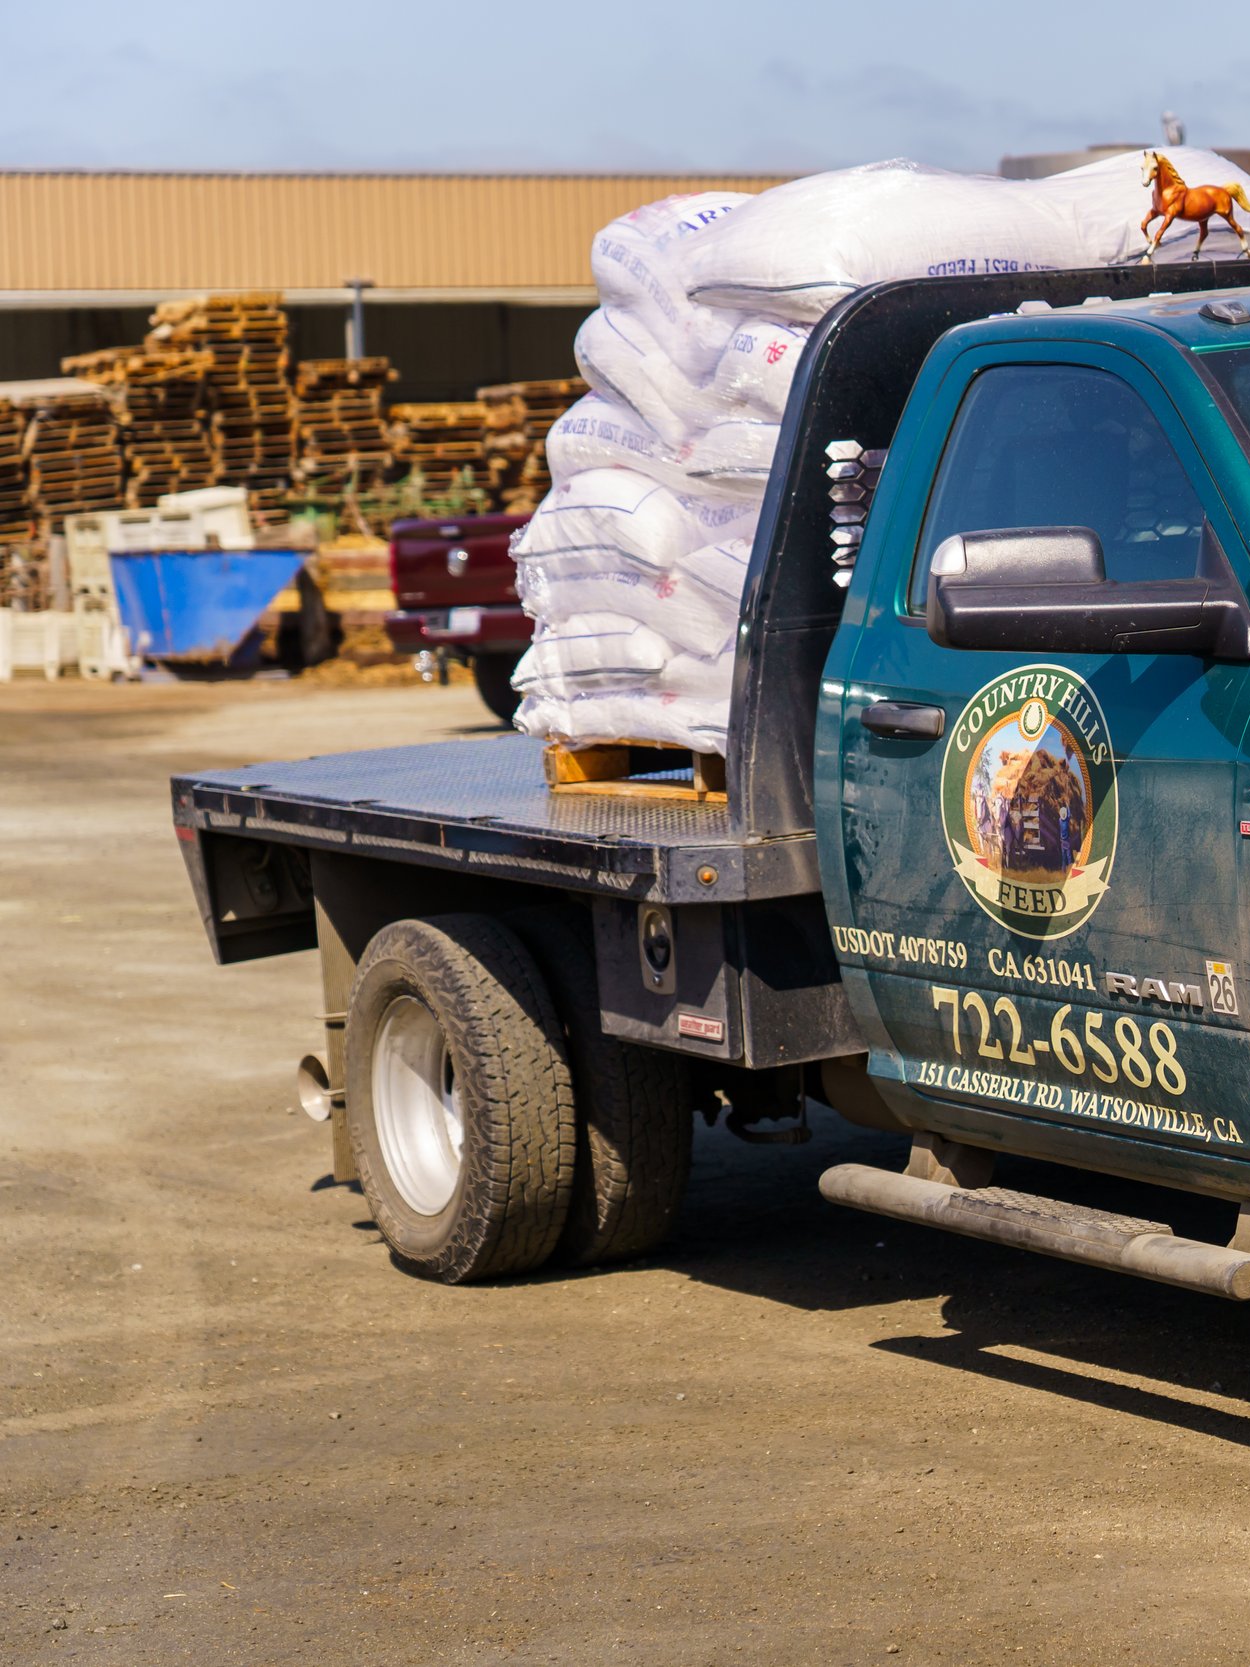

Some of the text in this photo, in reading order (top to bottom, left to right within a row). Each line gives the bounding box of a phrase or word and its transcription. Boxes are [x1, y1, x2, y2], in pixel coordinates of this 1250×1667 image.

[956, 673, 1108, 766] COUNTRY HILLS
[995, 878, 1067, 914] FEED
[833, 926, 968, 969] USDOT 4078759
[988, 948, 1096, 991] CA 631041
[1105, 971, 1204, 1008] RAM
[1210, 974, 1236, 1012] 26
[932, 986, 1187, 1096] 722-6588
[917, 1061, 1244, 1144] 151 CASSERLY RD. WATSONVILLE, CA
